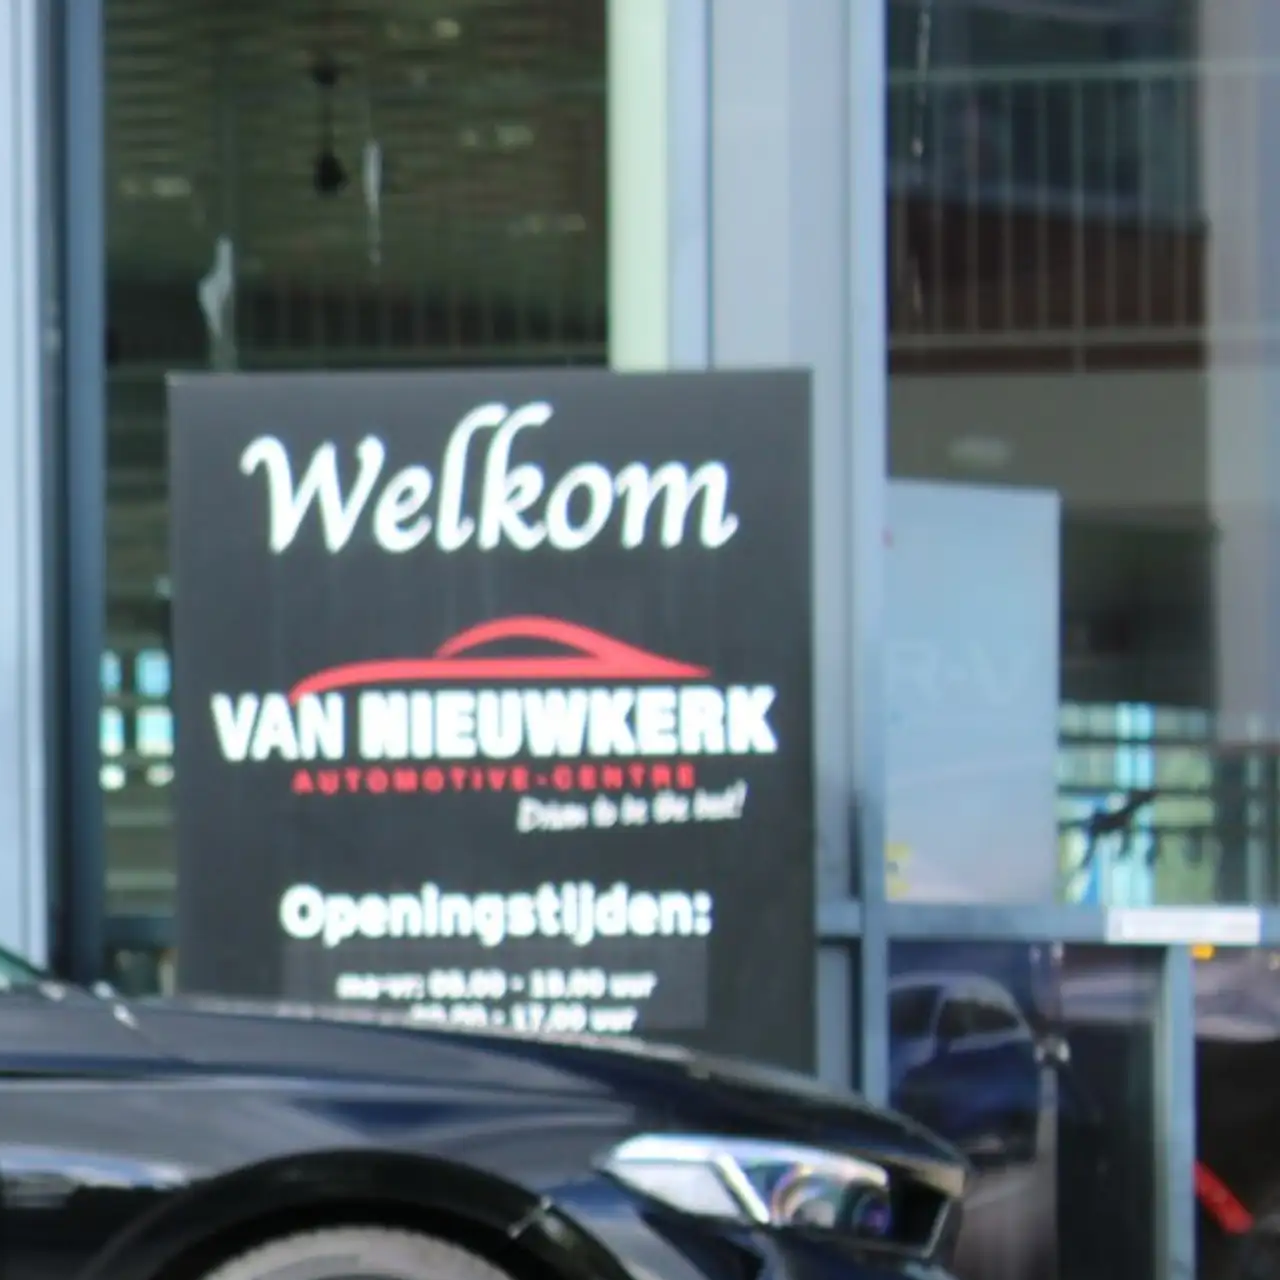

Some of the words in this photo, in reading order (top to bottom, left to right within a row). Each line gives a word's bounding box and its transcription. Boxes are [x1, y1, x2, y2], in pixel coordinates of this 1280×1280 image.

[241, 402, 738, 553] Welkom
[211, 692, 344, 761] VAN
[358, 686, 777, 758] NIEUWKERK
[280, 882, 712, 946] Openingstijden:
